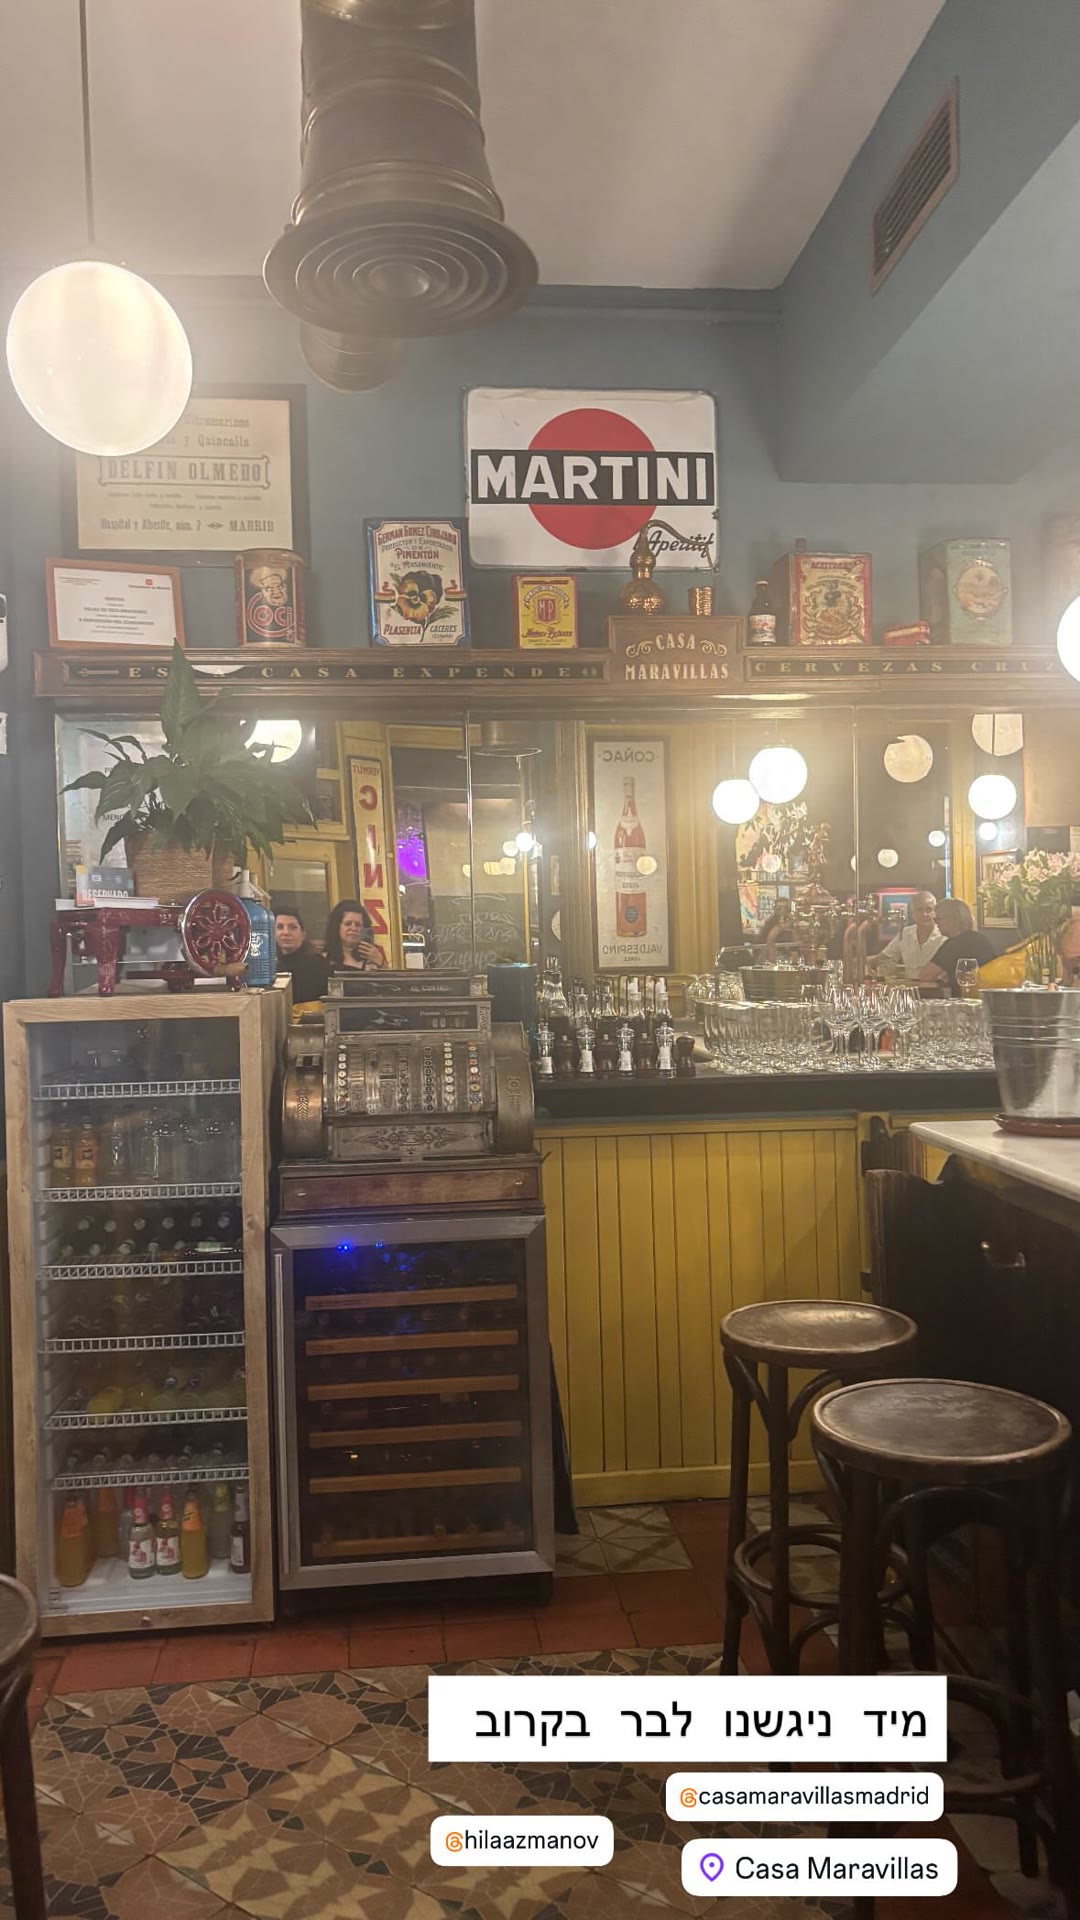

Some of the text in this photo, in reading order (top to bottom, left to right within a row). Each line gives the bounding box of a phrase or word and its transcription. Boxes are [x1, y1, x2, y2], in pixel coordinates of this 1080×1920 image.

[108, 460, 262, 482] DELFIN OLMEDO
[477, 455, 707, 500] MARTINI
[229, 520, 274, 532] MADRID
[383, 624, 421, 635] PLASENCIA
[656, 633, 696, 650] CASA
[128, 666, 571, 679] ESA CASA EXPENDE
[624, 663, 730, 681] MARAVILLAS
[754, 660, 943, 673] CERVEZAS
